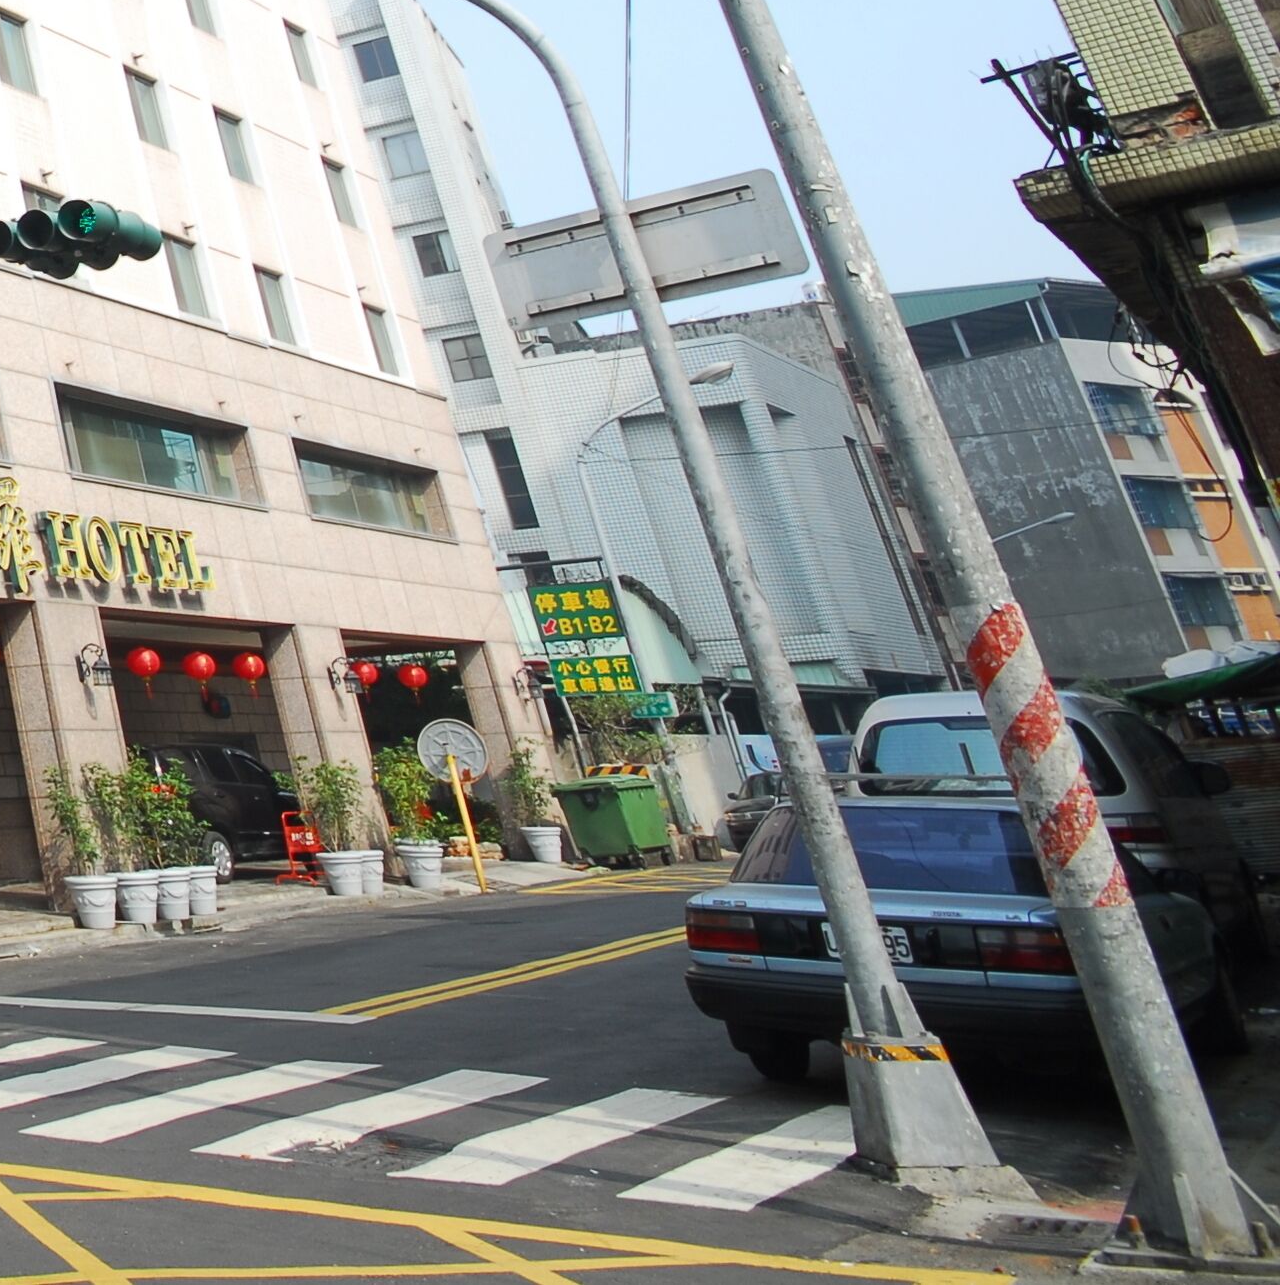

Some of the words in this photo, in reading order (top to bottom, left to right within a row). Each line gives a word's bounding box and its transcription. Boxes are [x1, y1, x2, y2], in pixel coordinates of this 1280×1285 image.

[38, 511, 216, 592] HOTEL
[534, 589, 611, 614] 停車場
[557, 658, 629, 676] 小心慢行
[561, 676, 635, 694] 車輛進出
